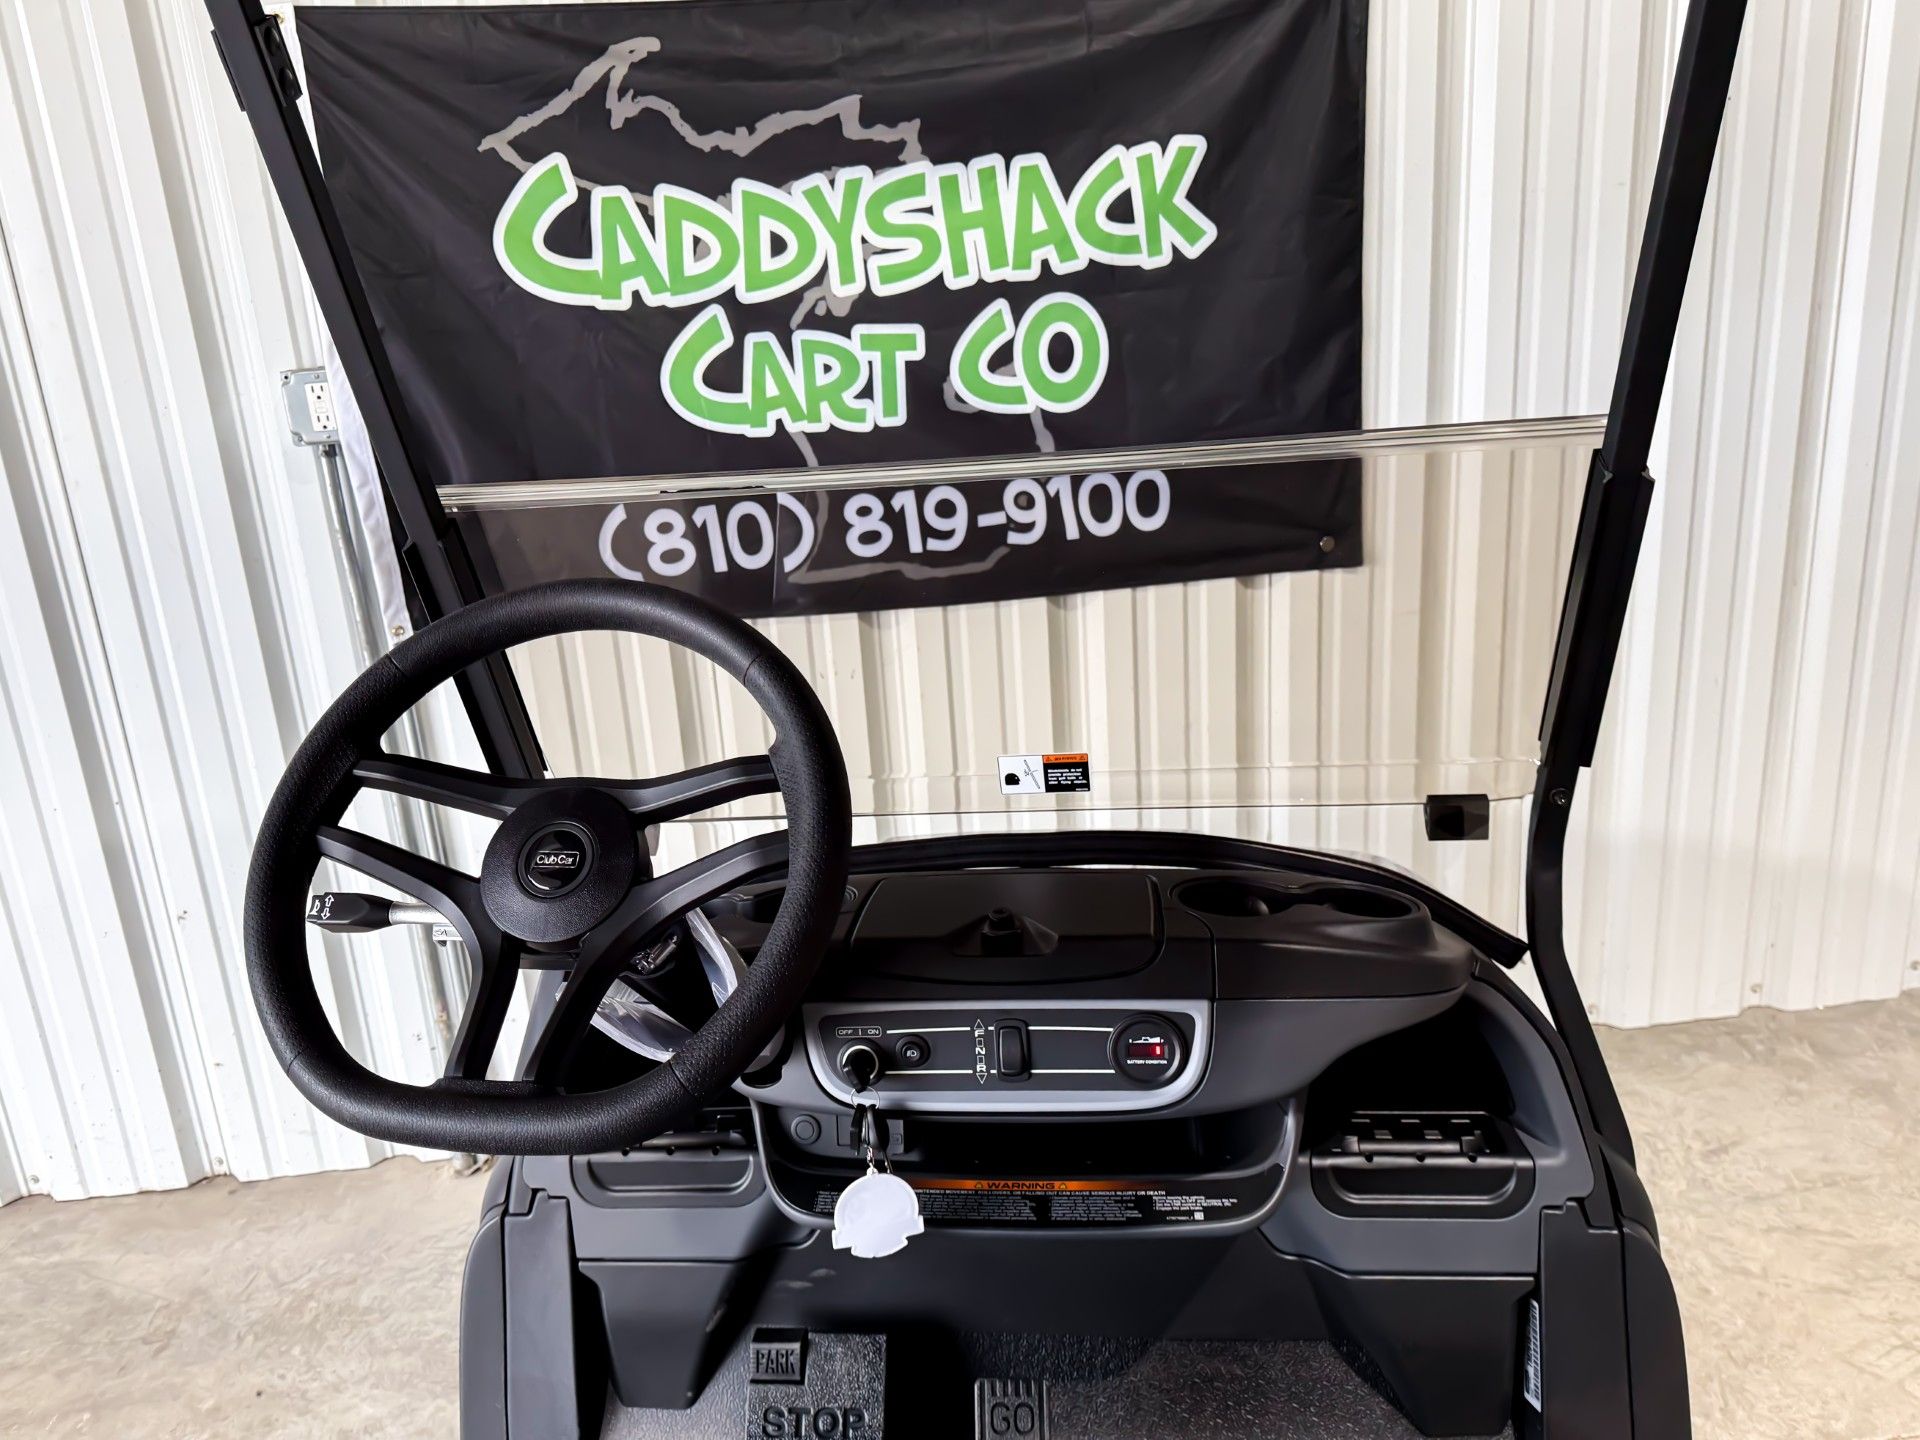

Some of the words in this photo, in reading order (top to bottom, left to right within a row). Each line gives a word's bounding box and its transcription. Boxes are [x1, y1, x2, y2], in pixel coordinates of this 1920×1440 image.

[495, 135, 1216, 309] CADDYSHACK
[661, 304, 925, 436] CART
[950, 292, 1108, 413] CO
[599, 492, 815, 582] (810)
[843, 470, 1171, 558] 819-9100
[536, 854, 557, 865] Club
[557, 854, 574, 865] Car
[867, 1028, 880, 1036] ON
[975, 1047, 986, 1055] N
[976, 1065, 987, 1073] R
[987, 1181, 1056, 1190] WARNING
[756, 1349, 796, 1374] PARK
[762, 1406, 866, 1440] STOP
[991, 1401, 1035, 1436] GO
